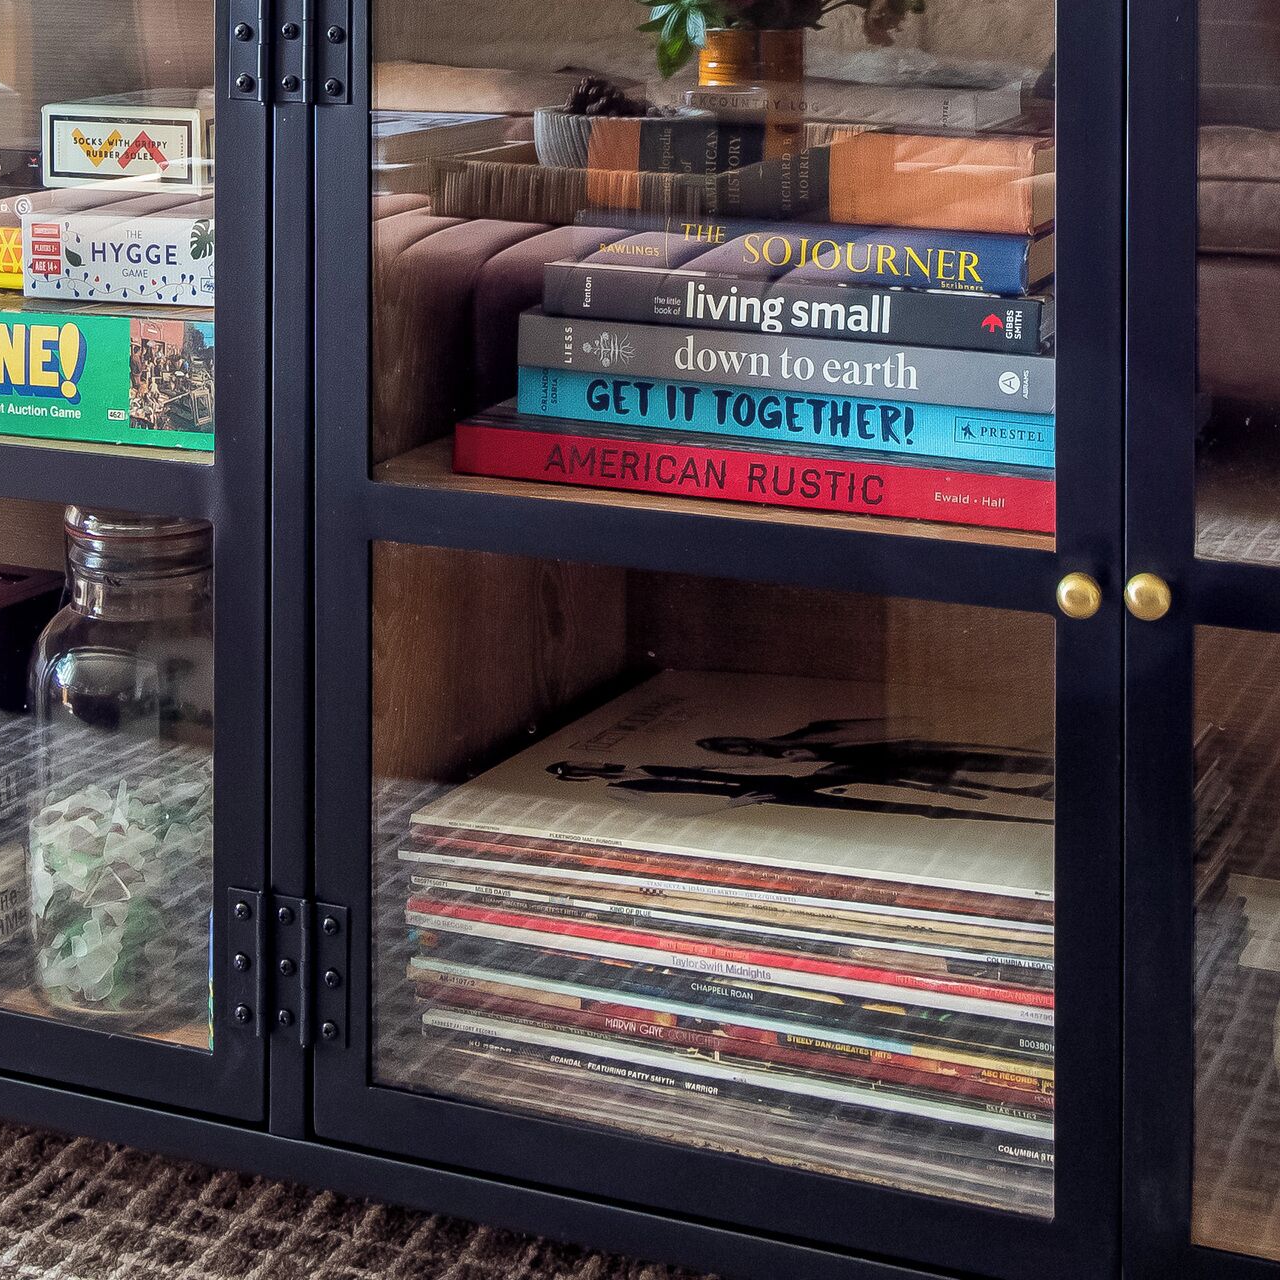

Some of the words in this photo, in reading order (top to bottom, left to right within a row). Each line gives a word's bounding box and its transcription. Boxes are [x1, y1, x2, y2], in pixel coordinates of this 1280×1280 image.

[73, 136, 103, 147] SOCKS
[108, 138, 130, 148] WITH
[135, 140, 168, 149] GRIPPY
[86, 149, 120, 159] RUBBER
[124, 151, 154, 161] SOLES
[705, 129, 718, 210] AMERICAN
[728, 135, 741, 204] HISTORY
[782, 152, 792, 210] RICHARD
[800, 148, 810, 199] MORRIS
[125, 230, 142, 239] THE
[91, 241, 177, 266] HYGGE
[599, 243, 660, 257] RAWLINGS
[681, 223, 727, 244] THE
[742, 234, 984, 283] SOJOURNER
[35, 261, 46, 271] AGE
[47, 261, 58, 272] 14+
[122, 268, 149, 279] GAME
[583, 276, 592, 308] Fenton
[941, 281, 984, 291] Scribners
[654, 296, 665, 305] the
[666, 297, 681, 306] little
[654, 306, 671, 315] book
[673, 307, 681, 315] of
[686, 281, 784, 333] living
[790, 294, 891, 334] small
[1005, 309, 1014, 339] GIBBS
[1014, 310, 1023, 340] SMITH
[564, 326, 573, 364] LIESS
[675, 335, 770, 377] down
[779, 347, 815, 381] to
[822, 352, 920, 391] earth
[1022, 370, 1030, 400] ABRAMS
[7, 403, 48, 417] Auction
[50, 406, 81, 419] Game
[586, 379, 655, 417] GET
[666, 385, 702, 421] IT
[712, 389, 915, 446] TOGETHER!
[980, 426, 1045, 442] PRESTEL
[544, 443, 727, 490] AMERICAN
[747, 463, 885, 505] RUSTIC
[934, 491, 970, 505] Ewald
[982, 496, 1005, 508] Hall
[475, 886, 493, 895] MILES
[494, 888, 511, 897] DAVIS
[609, 906, 624, 914] KIND
[635, 909, 652, 917] BLUE
[671, 955, 699, 970] Taylor
[700, 958, 724, 973] Swift
[725, 963, 772, 981] Midnights
[986, 956, 1023, 967] COLUMBIA
[691, 982, 729, 997] CHAPPELL
[730, 989, 754, 1001] ROAN
[475, 1026, 498, 1037] RECORDS
[605, 1017, 637, 1033] MARVIN
[639, 1024, 665, 1038] GAYE
[787, 1034, 814, 1046] STEELY
[874, 1050, 892, 1060] HITS
[550, 1055, 582, 1068] SCANDAL
[587, 1062, 627, 1077] FEATURING
[627, 1070, 650, 1082] PATTY
[650, 1074, 675, 1086] SMYTH
[685, 1081, 719, 1095] WARRIOR
[981, 1069, 999, 1078] ABC
[998, 1144, 1040, 1162] COLUMBIA
